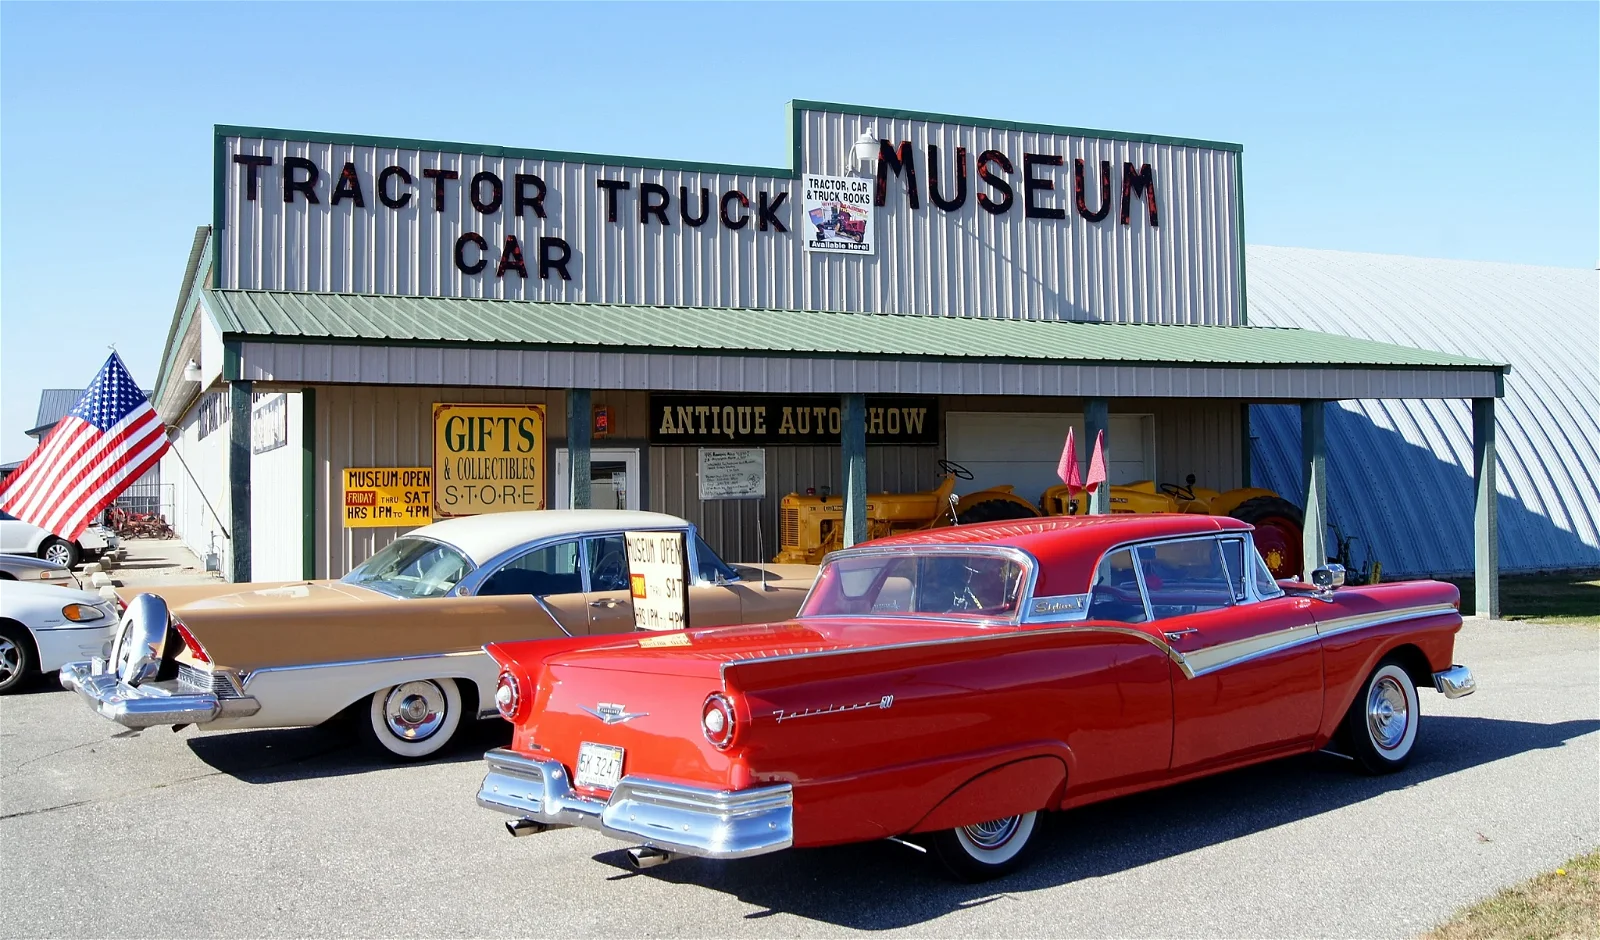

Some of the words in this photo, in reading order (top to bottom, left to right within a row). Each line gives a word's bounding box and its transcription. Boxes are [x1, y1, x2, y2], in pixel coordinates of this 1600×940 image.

[233, 154, 547, 218] TRACTOR
[597, 179, 788, 232] TRUCK
[809, 178, 849, 192] TRACTOR,
[851, 182, 868, 193] CAR
[875, 138, 1160, 227] MUSEUM
[806, 190, 812, 200] &
[813, 190, 841, 202] TRUCK
[843, 192, 870, 205] BOOKS
[455, 232, 572, 281] CAR
[811, 241, 846, 249] Available
[848, 242, 869, 251] Here!
[659, 405, 766, 439] ANTIQUE
[778, 406, 842, 434] AUTO
[864, 407, 927, 434] HOW
[444, 415, 535, 453] GIFTS
[349, 471, 398, 488] MUSEUM
[403, 471, 430, 487] OPEN
[444, 457, 451, 481] &
[457, 457, 535, 481] COLLECTIBLES
[381, 496, 399, 504] THRU
[404, 491, 430, 504] SAT
[348, 506, 368, 519] HRS
[405, 506, 429, 517] 4PM
[627, 538, 655, 563] MUSEUM
[660, 538, 682, 564] OPEN
[666, 578, 683, 598] SAT
[773, 701, 871, 723] Fairlane
[594, 755, 621, 780] 3247
